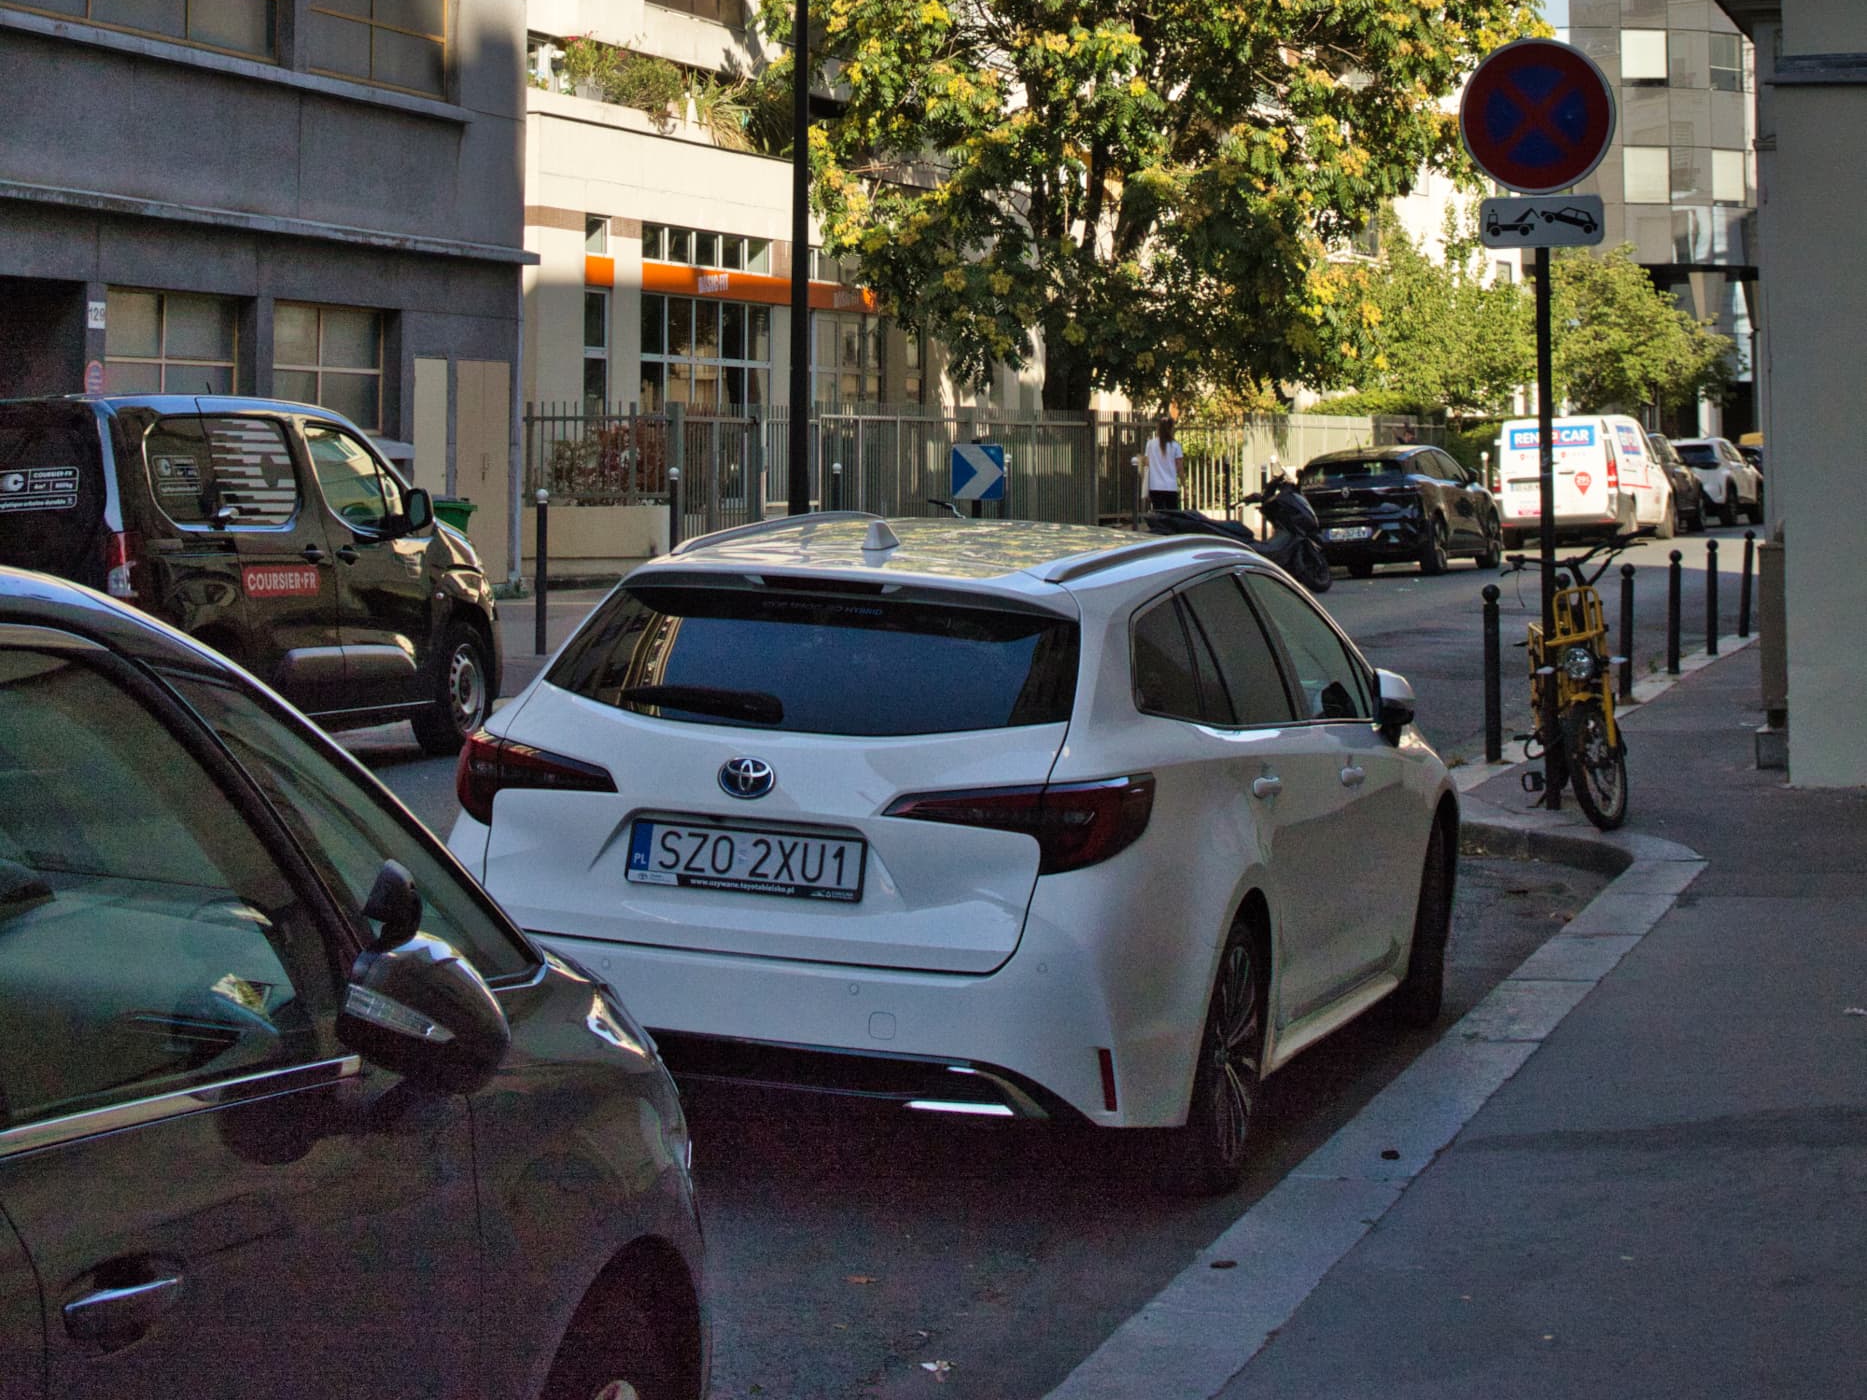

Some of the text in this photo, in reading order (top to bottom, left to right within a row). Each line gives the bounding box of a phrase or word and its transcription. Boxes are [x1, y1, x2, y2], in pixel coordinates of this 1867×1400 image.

[88, 307, 105, 322] 129
[1561, 429, 1589, 442] CAR
[633, 852, 648, 865] PL
[748, 838, 846, 886] 2XU1
